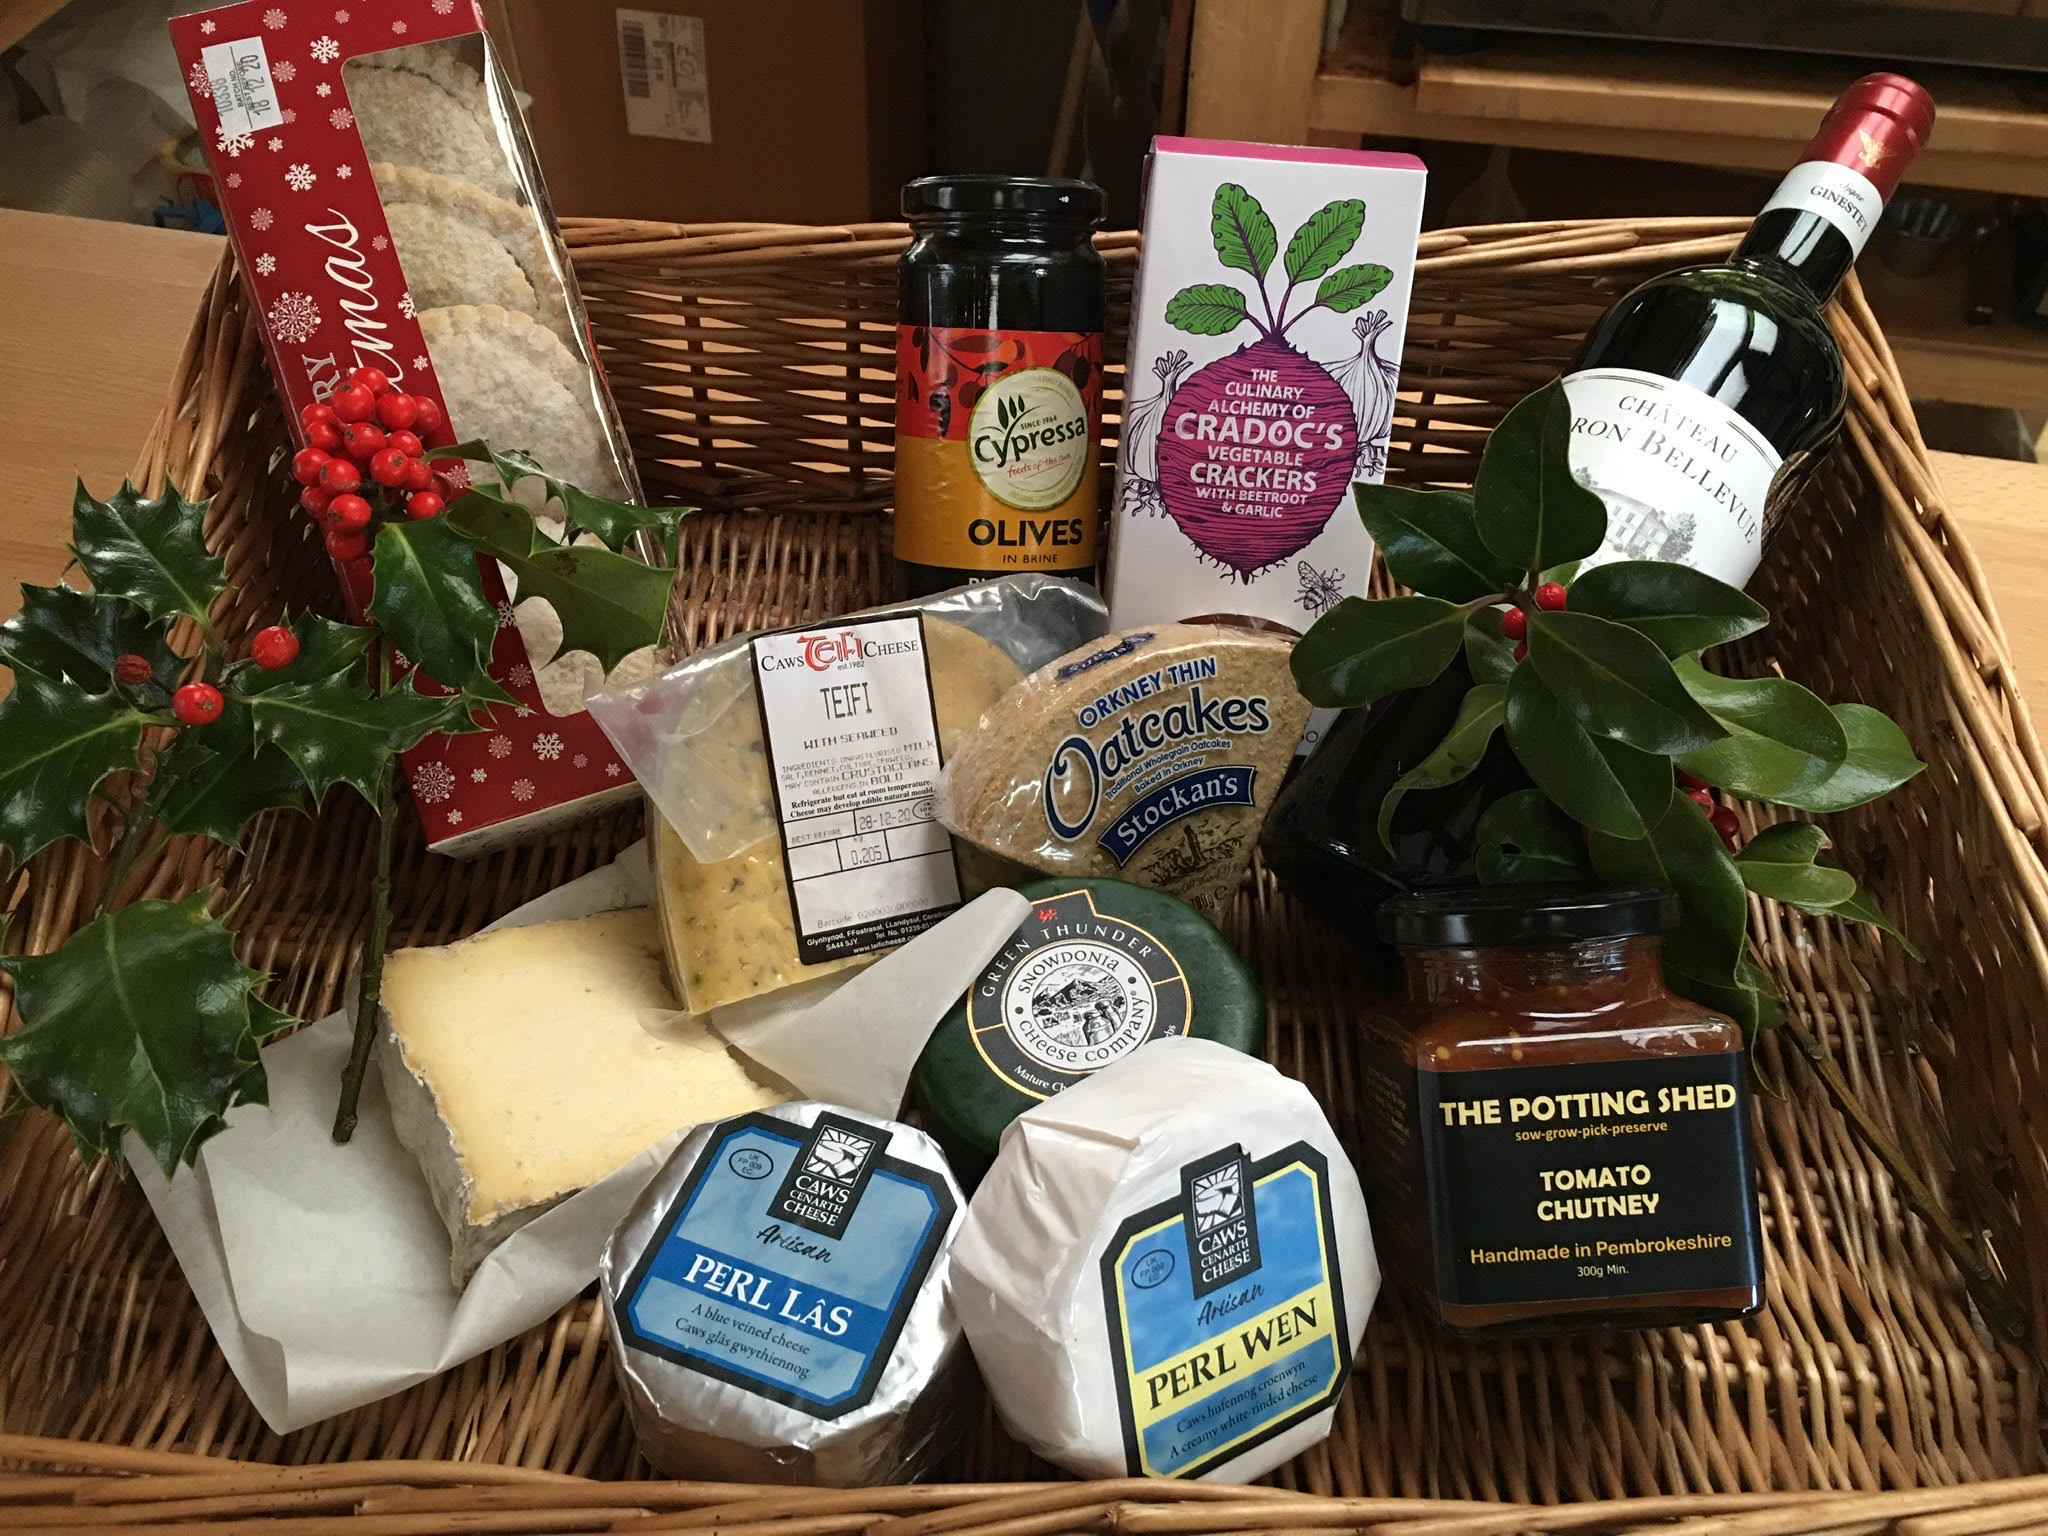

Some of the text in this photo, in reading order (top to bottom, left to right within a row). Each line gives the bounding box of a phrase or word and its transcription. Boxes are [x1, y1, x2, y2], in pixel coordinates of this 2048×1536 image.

[232, 83, 244, 107] BATCH
[240, 54, 271, 116] 18 12 20
[302, 352, 341, 403] RY
[1251, 368, 1278, 383] THE
[1225, 382, 1304, 400] CULINARY
[1207, 399, 1315, 419] ALCHEMY OF
[1020, 420, 1040, 430] SINCE
[1174, 412, 1343, 450] CRADOC'S
[1618, 395, 1738, 464] CHÂTEAU
[974, 416, 1086, 468] Cypressa
[1207, 446, 1304, 466] VEGETABLE
[1190, 463, 1318, 492] CRACKERS
[1570, 417, 1758, 544] RON BELLEVUE
[1195, 487, 1309, 505] WITH BEETROOT
[1221, 502, 1283, 518] & GARLIC
[968, 518, 1083, 547] OLIVES
[1003, 554, 1058, 564] IN BRINE
[761, 655, 805, 672] CAWS
[864, 640, 919, 658] CHEESE
[820, 682, 872, 720] TEIFI
[1079, 657, 1216, 727] ORKNEY THIN
[804, 727, 898, 750] WITH SEAWEED
[1044, 686, 1270, 841] Oatcakes
[1105, 739, 1231, 800] Traditional Wholegrain Oatcakes
[1134, 774, 1162, 793] Baked
[1172, 756, 1204, 772] Orkney
[790, 809, 815, 818] Cheese
[817, 805, 832, 814] may
[833, 799, 860, 810] develop
[862, 795, 883, 805] edible
[884, 791, 910, 801] natural
[791, 797, 832, 810] Refrigerate
[833, 794, 845, 802] but
[846, 791, 858, 799] eat
[868, 787, 886, 796] room
[1117, 773, 1238, 847] Stockan's
[859, 808, 910, 830] 28-12-20
[791, 834, 810, 844] BEST
[850, 845, 882, 866] 0.205
[817, 915, 852, 929] Barcode
[982, 923, 1152, 997] GREEN THUNDER
[1013, 1065, 1049, 1089] Mature
[1440, 1083, 1737, 1126] THE POTTING SHED
[1515, 1120, 1668, 1142] sow-grow-pick-preserve
[795, 1175, 850, 1204] CAWS
[1540, 1164, 1651, 1191] TOMATO
[783, 1200, 837, 1227] CHEESE
[789, 1189, 844, 1214] CENARTH
[1536, 1193, 1659, 1222] CHUTNEY
[757, 1224, 832, 1264] Artisan
[1198, 1219, 1248, 1255] CAWS
[1470, 1234, 1732, 1265] Handmade in Pembrokeshire
[1201, 1238, 1250, 1268] CENARTH
[1202, 1250, 1251, 1283] CHEESE
[1576, 1263, 1629, 1279] 300g Min.
[683, 1253, 853, 1336] PERL LÂS
[1197, 1282, 1264, 1326] Artisan
[691, 1303, 810, 1355] A blue veined cheese
[675, 1318, 810, 1380] Caws glâs gwythiennog
[1146, 1297, 1318, 1410] PERL WEN
[1176, 1362, 1306, 1433] Caws hufennog croenwyn
[1170, 1374, 1319, 1459] A creamy white rinded cheese
